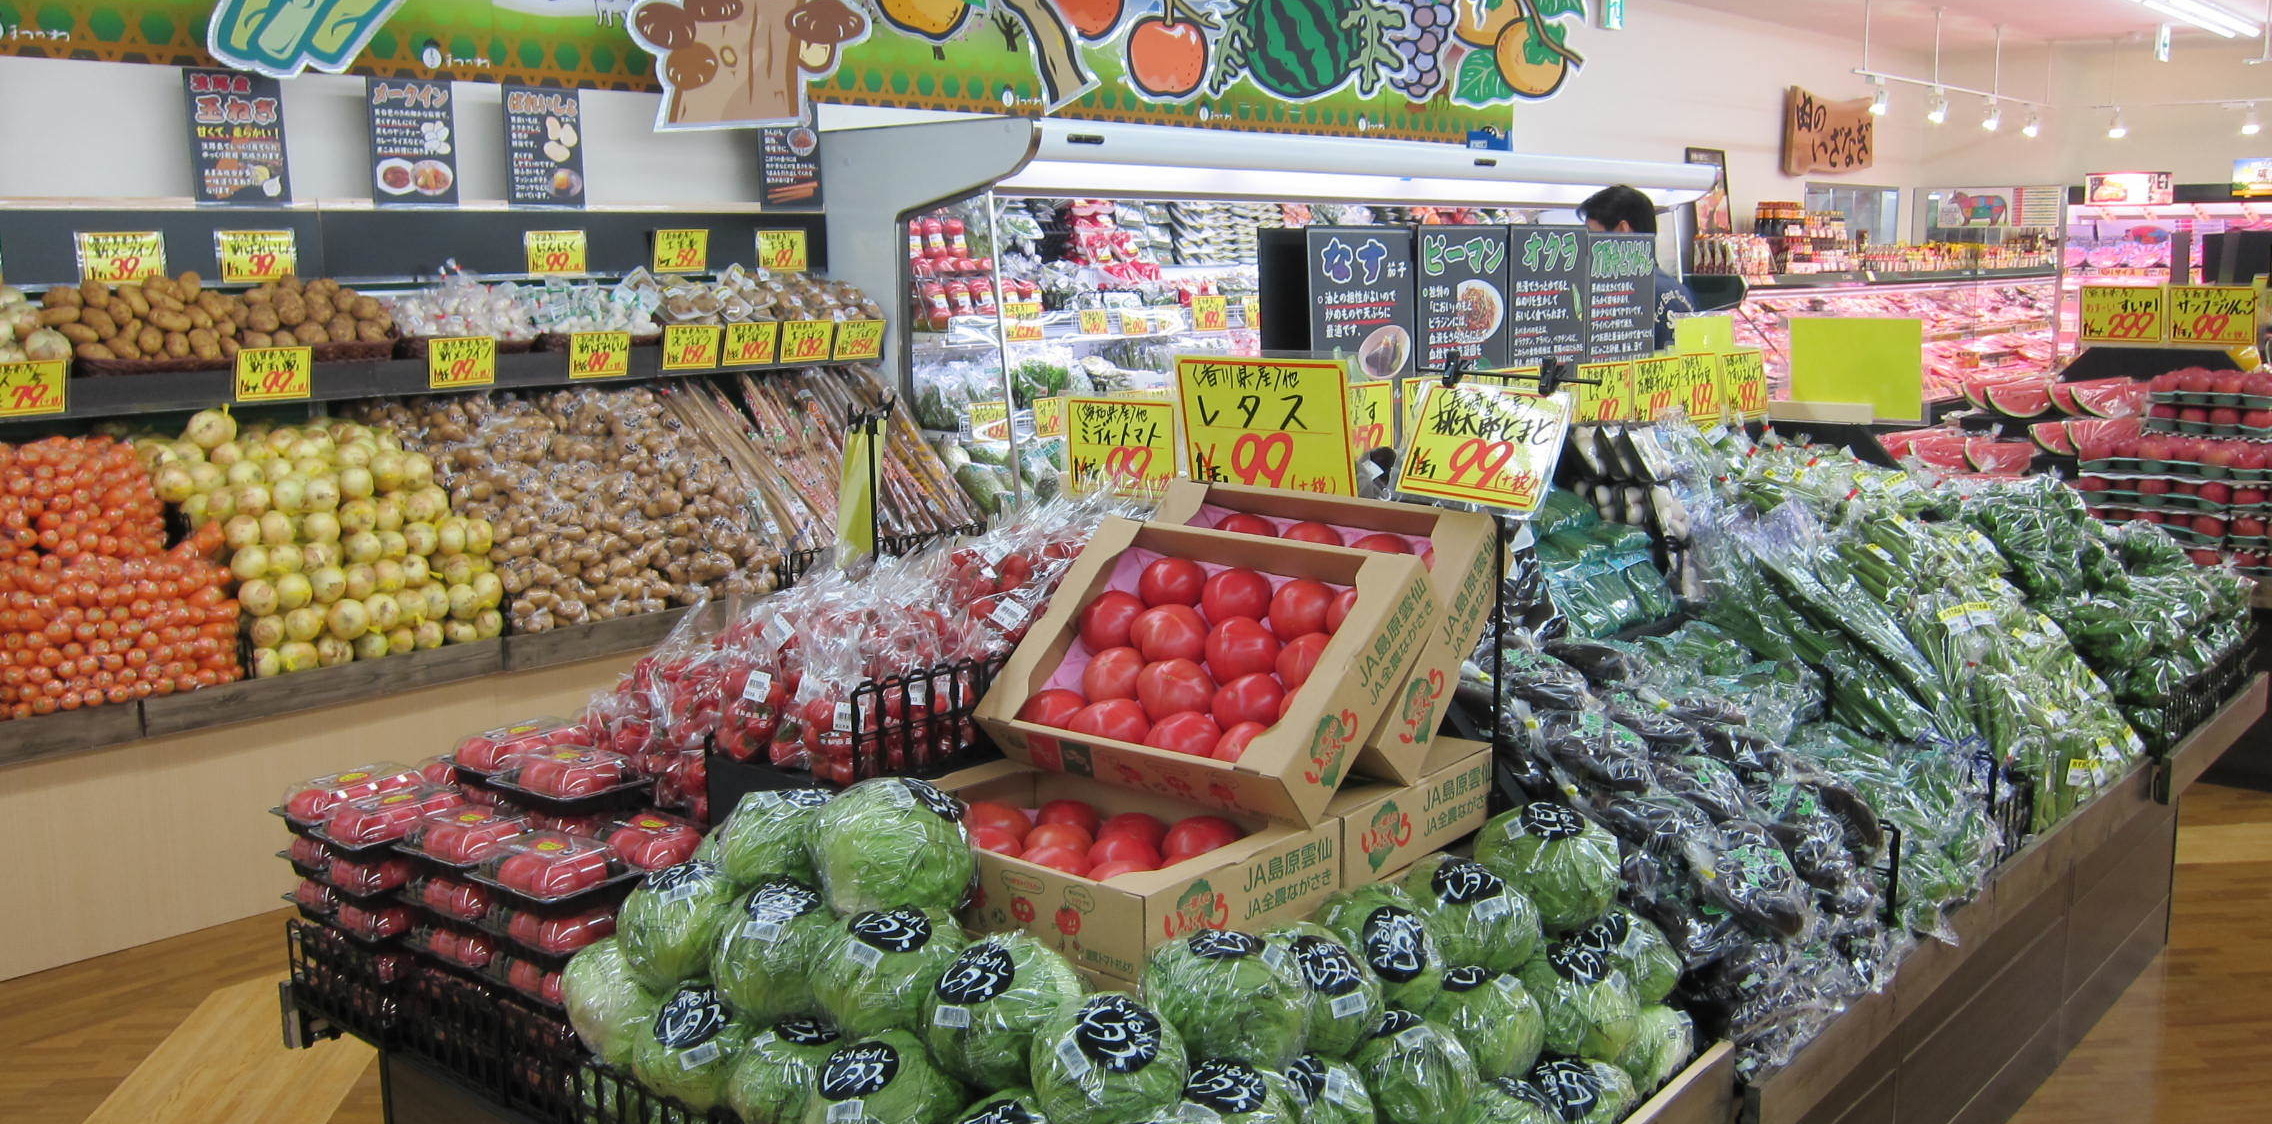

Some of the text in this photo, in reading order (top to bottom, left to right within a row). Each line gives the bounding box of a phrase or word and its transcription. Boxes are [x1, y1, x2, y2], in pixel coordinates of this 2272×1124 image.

[373, 82, 449, 109] メークイン
[507, 91, 578, 117] ばれいしょ
[195, 94, 278, 125] 玉ねぎ
[1796, 91, 1827, 133] 肉の
[1811, 118, 1872, 169] いざなぎ
[536, 241, 577, 253] にんにく
[675, 248, 699, 268] 59
[774, 249, 795, 269] 99
[1424, 234, 1505, 277] ピーマン
[1522, 231, 1579, 273] オクラ
[110, 256, 141, 280] 39
[248, 254, 277, 277] 39
[545, 251, 570, 273] 99
[1321, 236, 1407, 286] なす 茄子
[1324, 289, 1397, 305] 油との相性がよいので
[1429, 285, 1450, 299] 独特の
[1325, 307, 1391, 322] 炒めものや天ぷらに
[2107, 311, 2156, 339] 299
[2191, 313, 2230, 341] 99
[1326, 324, 1361, 339] 最適です。
[679, 344, 708, 364] 159
[739, 340, 769, 360] 199
[795, 336, 823, 357] 139
[849, 336, 876, 355] 259
[450, 358, 478, 381] 99
[586, 351, 611, 371] 99
[11, 382, 49, 409] 79
[262, 370, 296, 395] 99
[1738, 379, 1760, 411] 399
[1599, 397, 1621, 421] 99
[1691, 382, 1714, 416] 199
[1197, 394, 1308, 432] レタス
[1429, 406, 1555, 445] 桃太郎とまと
[1081, 421, 1163, 446] ミディートマト
[1106, 445, 1152, 489] 99
[1231, 431, 1294, 488] 99
[1447, 436, 1515, 489] 99
[1359, 576, 1428, 689] JA島原雲仙
[1369, 597, 1434, 707] JA全農ながさき
[1423, 761, 1492, 813] JA島原雲仙
[1243, 836, 1333, 893] JA島原雲仙
[1243, 867, 1333, 921] JA全農ながさき
